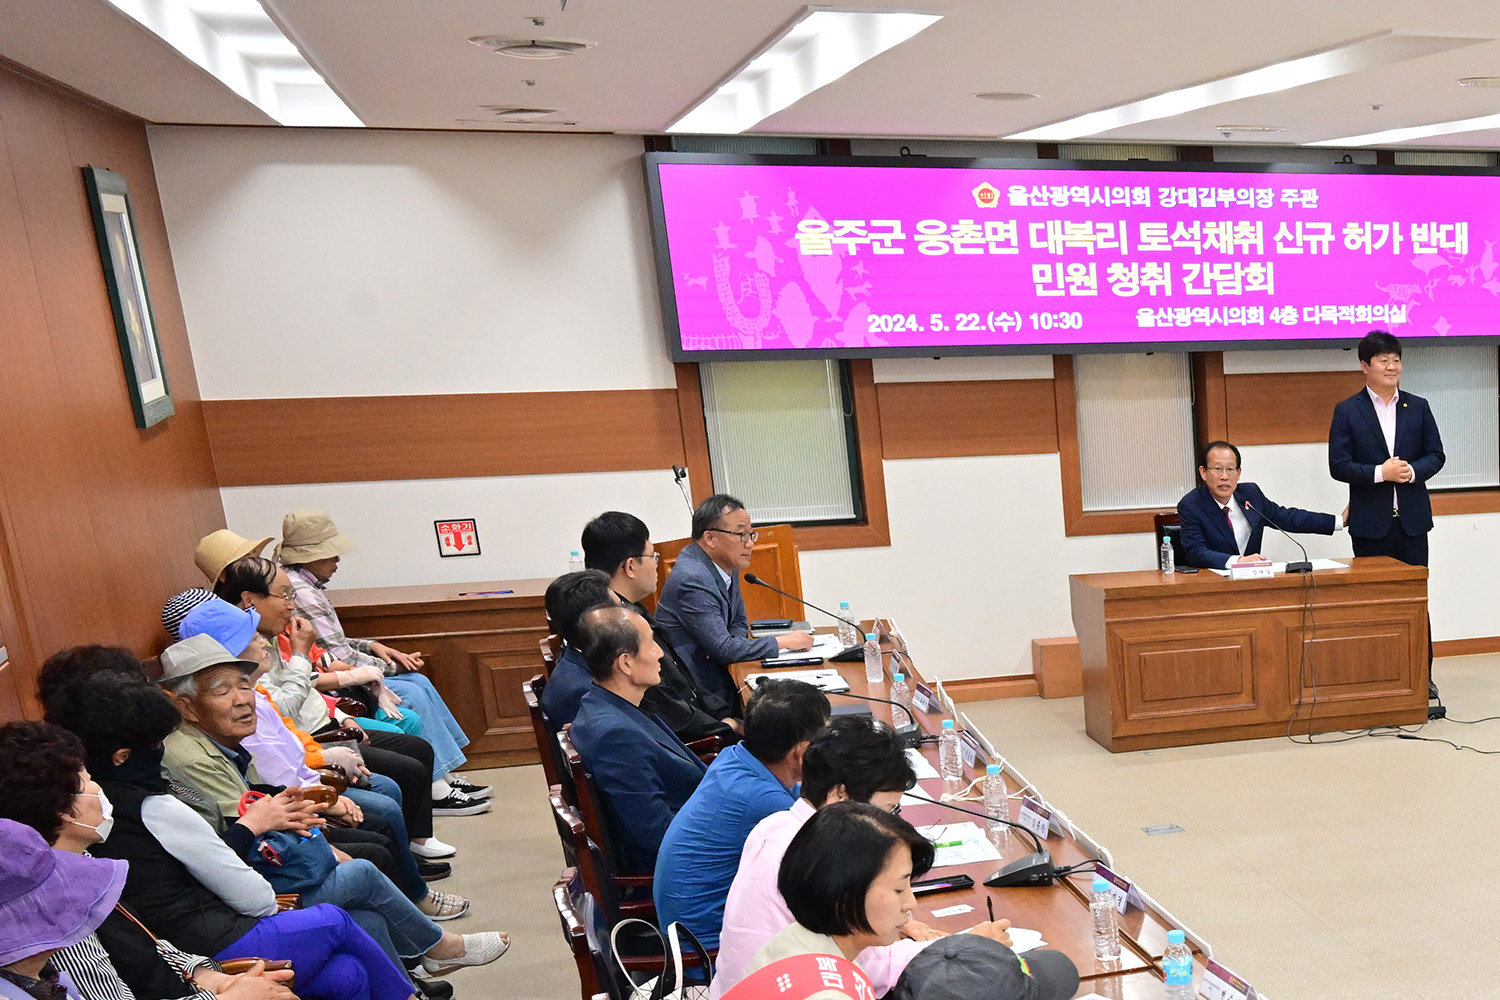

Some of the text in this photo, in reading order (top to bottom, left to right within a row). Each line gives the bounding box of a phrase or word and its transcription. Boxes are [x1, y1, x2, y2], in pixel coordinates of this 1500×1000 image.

[1007, 185, 1319, 208] 울산광역시의회 강대길부의장 주관
[796, 219, 1469, 256] 울주군 웅촌면 대복리 토석채취 신규 허가 반대
[1032, 261, 1275, 297] 민원 청취 간담회
[868, 311, 1083, 332] 2024. 5. 22.(수) 10:30
[1136, 303, 1406, 327] 울산광역시의회 4층 다목적회의실
[440, 523, 472, 533] 소화기
[816, 957, 844, 989] 대복
